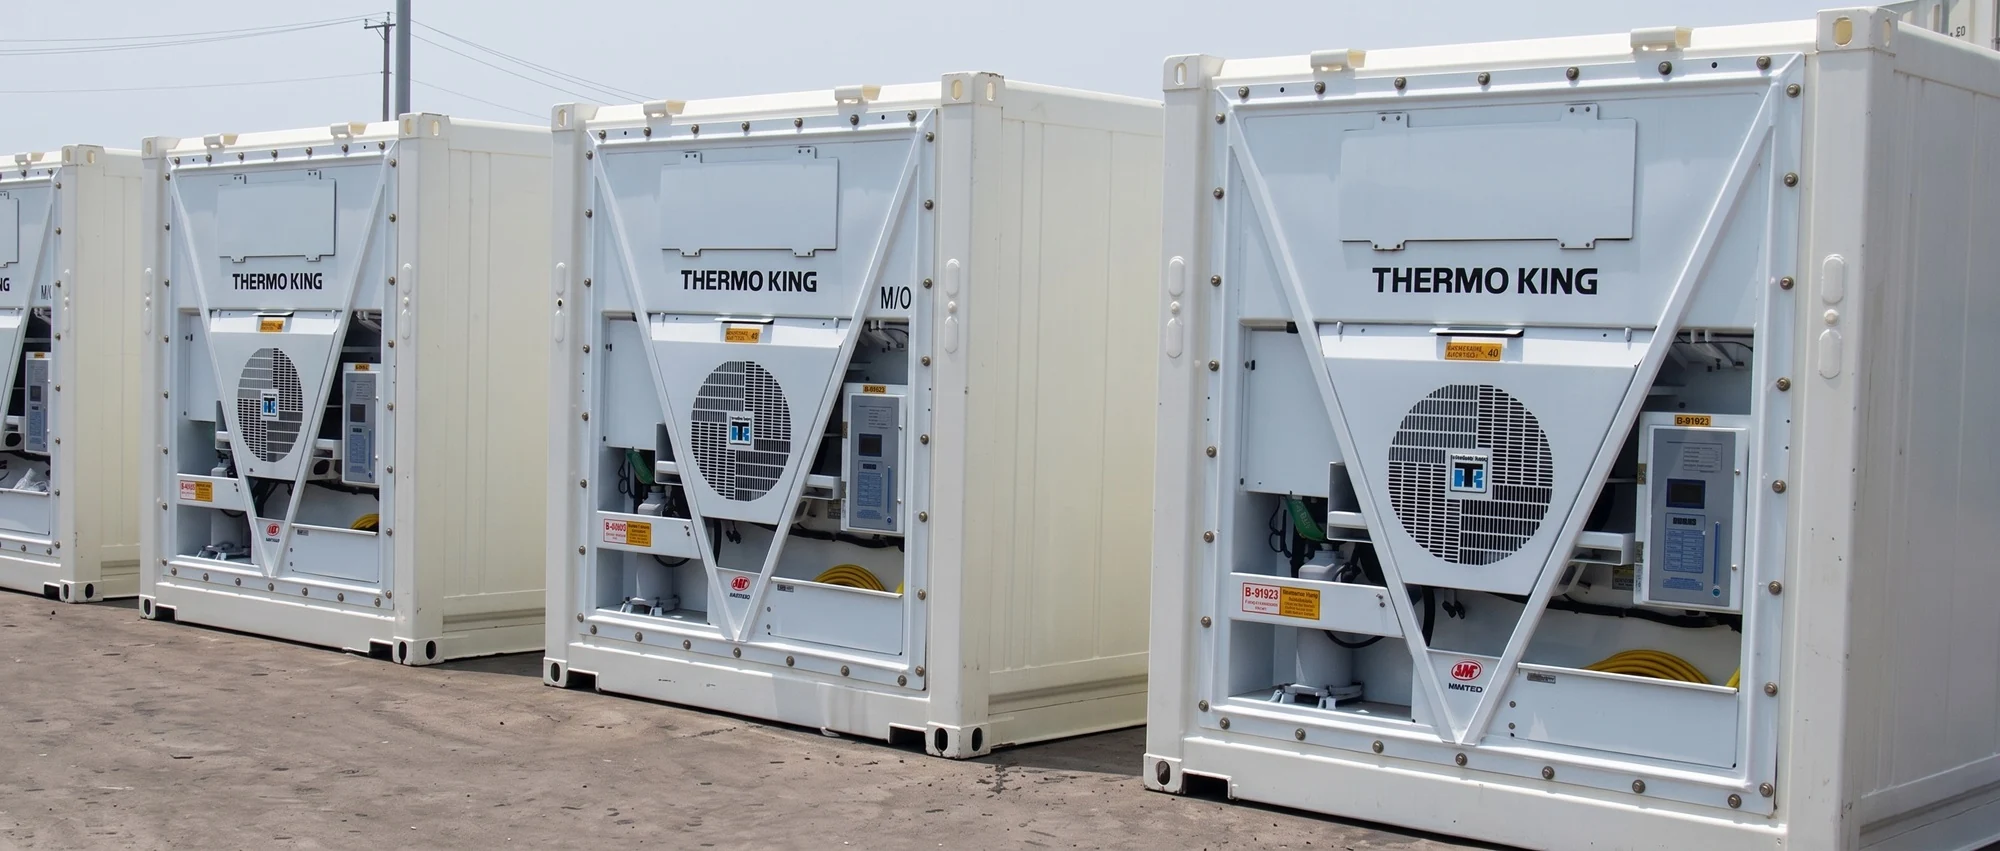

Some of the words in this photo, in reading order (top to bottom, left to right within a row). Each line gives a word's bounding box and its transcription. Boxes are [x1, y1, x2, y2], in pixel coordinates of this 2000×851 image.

[232, 273, 288, 290] THERMO
[290, 272, 323, 290] KING
[681, 270, 763, 291] THERMO
[768, 270, 817, 293] KING
[1372, 267, 1509, 294] THERMO
[1517, 267, 1598, 295] KING
[880, 286, 912, 310] M/O
[1487, 348, 1499, 358] 40
[1675, 416, 1710, 426] B-91923
[1245, 586, 1279, 600] B-91923
